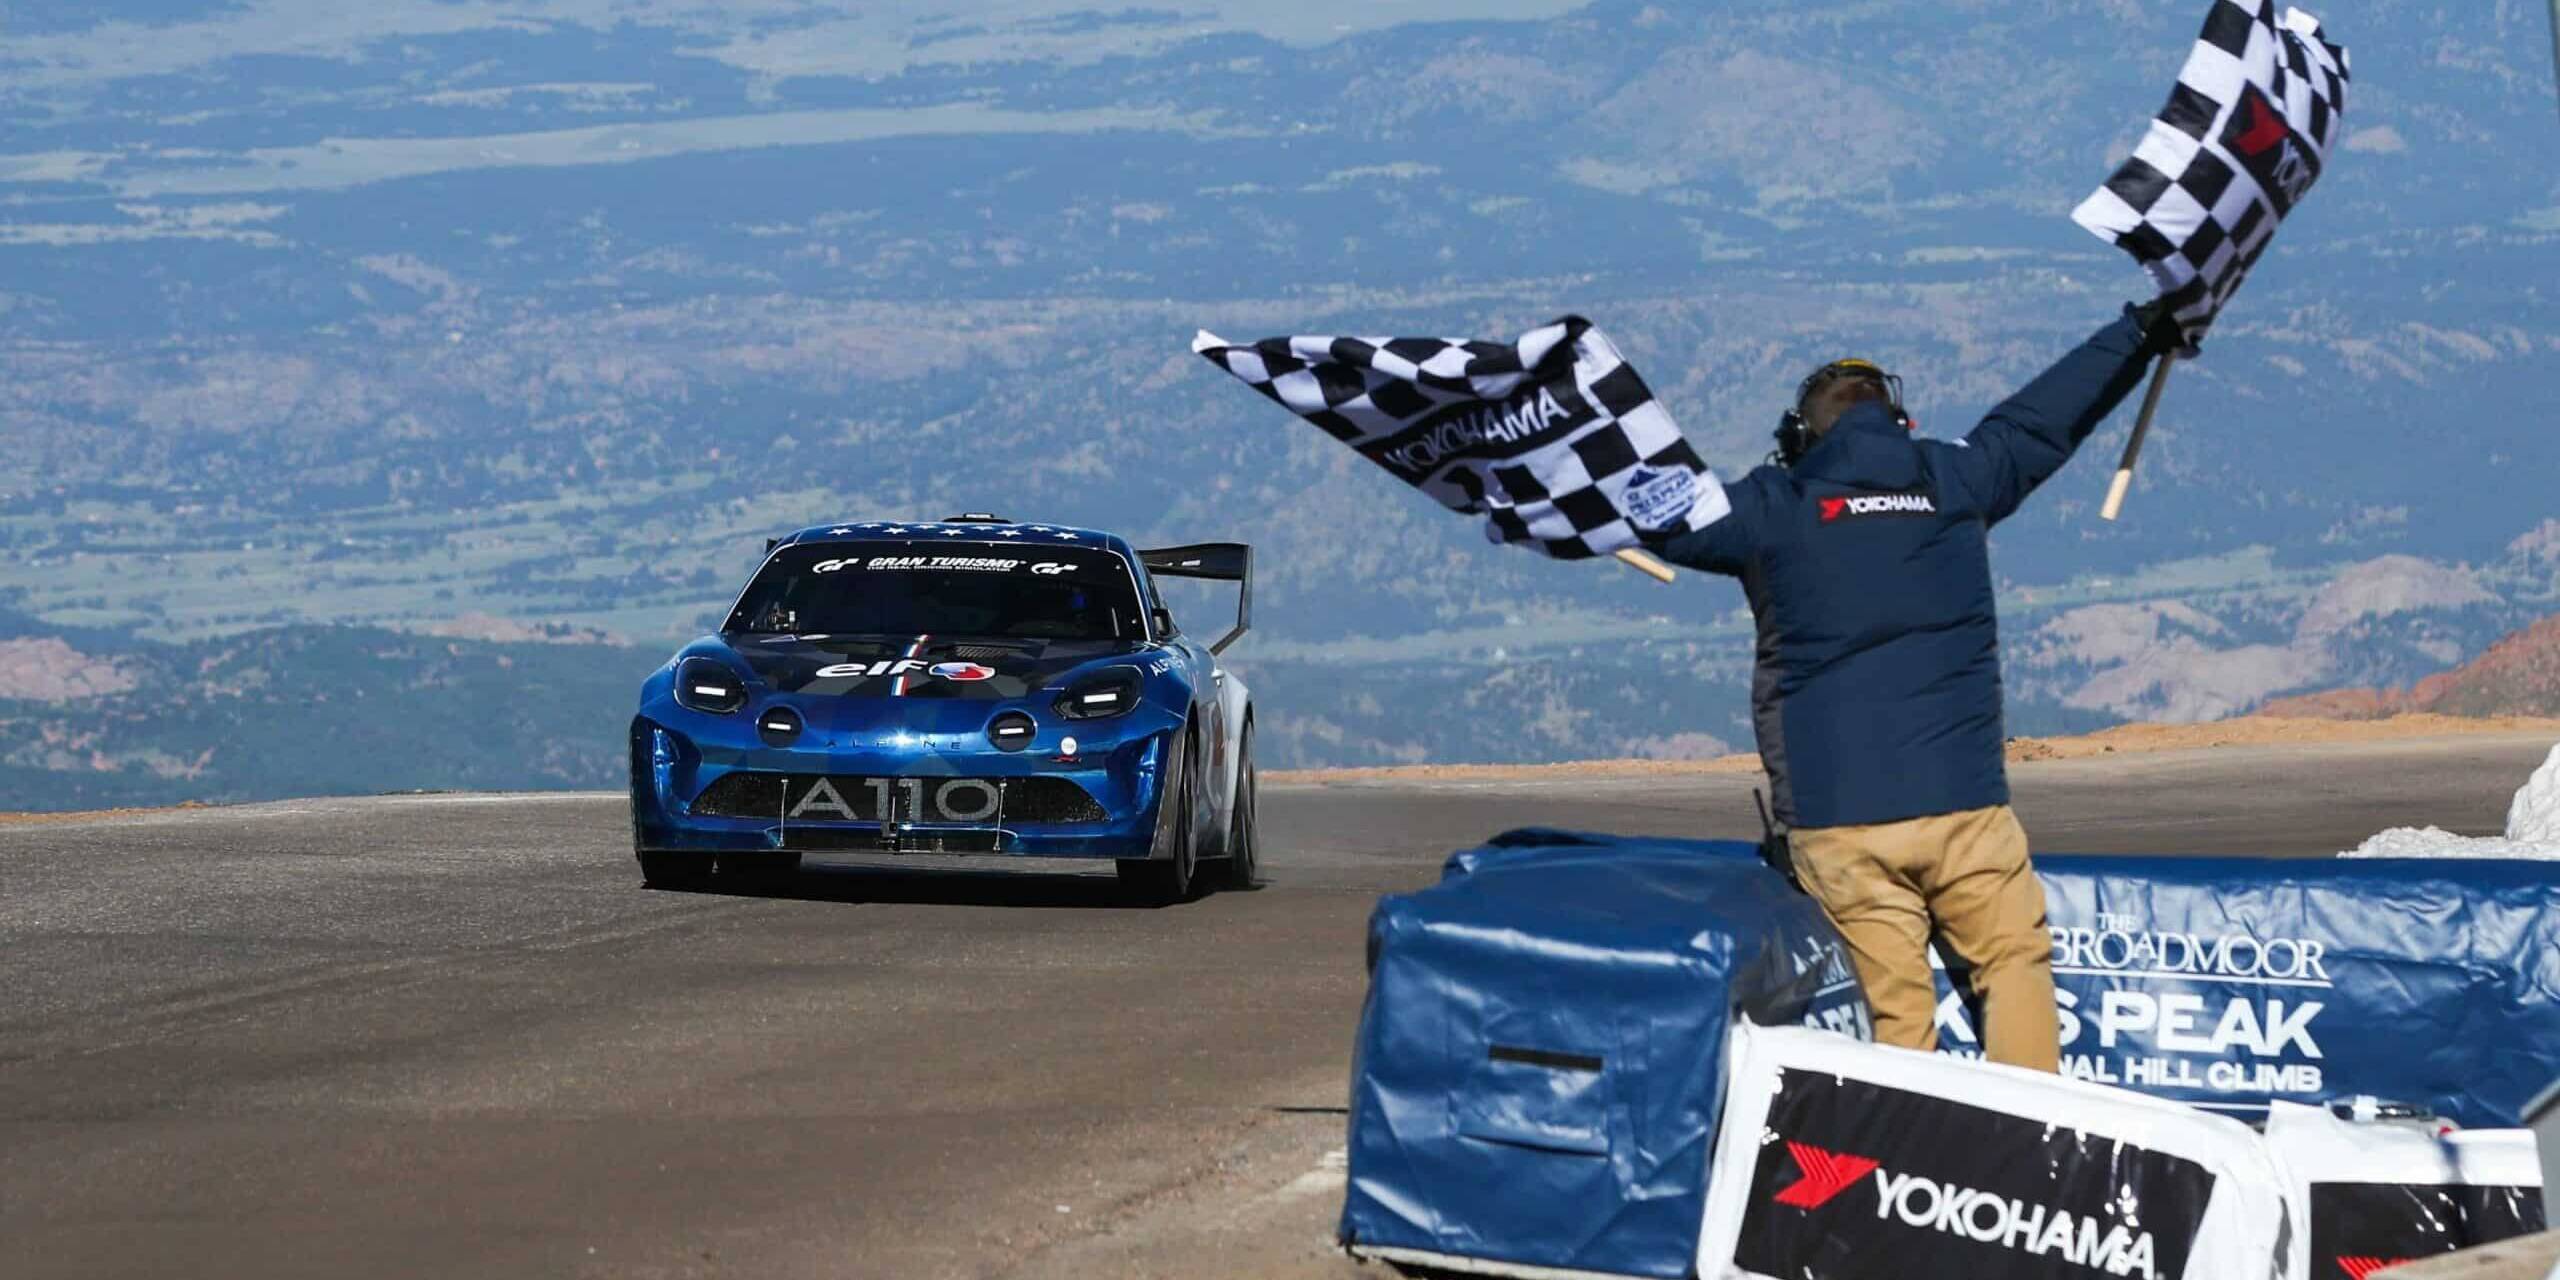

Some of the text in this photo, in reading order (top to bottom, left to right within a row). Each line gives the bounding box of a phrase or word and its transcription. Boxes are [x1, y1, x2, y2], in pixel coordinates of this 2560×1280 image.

[1846, 494, 1936, 515] YOKOHAMA
[867, 556, 1019, 569] GRAN TURISMO
[815, 659, 929, 678] elf
[825, 739, 961, 750] ALPNE
[788, 776, 999, 821] A110
[2098, 912, 2136, 931] THE
[2050, 926, 2330, 980] BROADMOOR
[2100, 990, 2324, 1059] PEAK
[2125, 1056, 2203, 1089] HILL
[2207, 1061, 2323, 1093] CLIMB
[1875, 1167, 2155, 1280] YOKOHAMA
